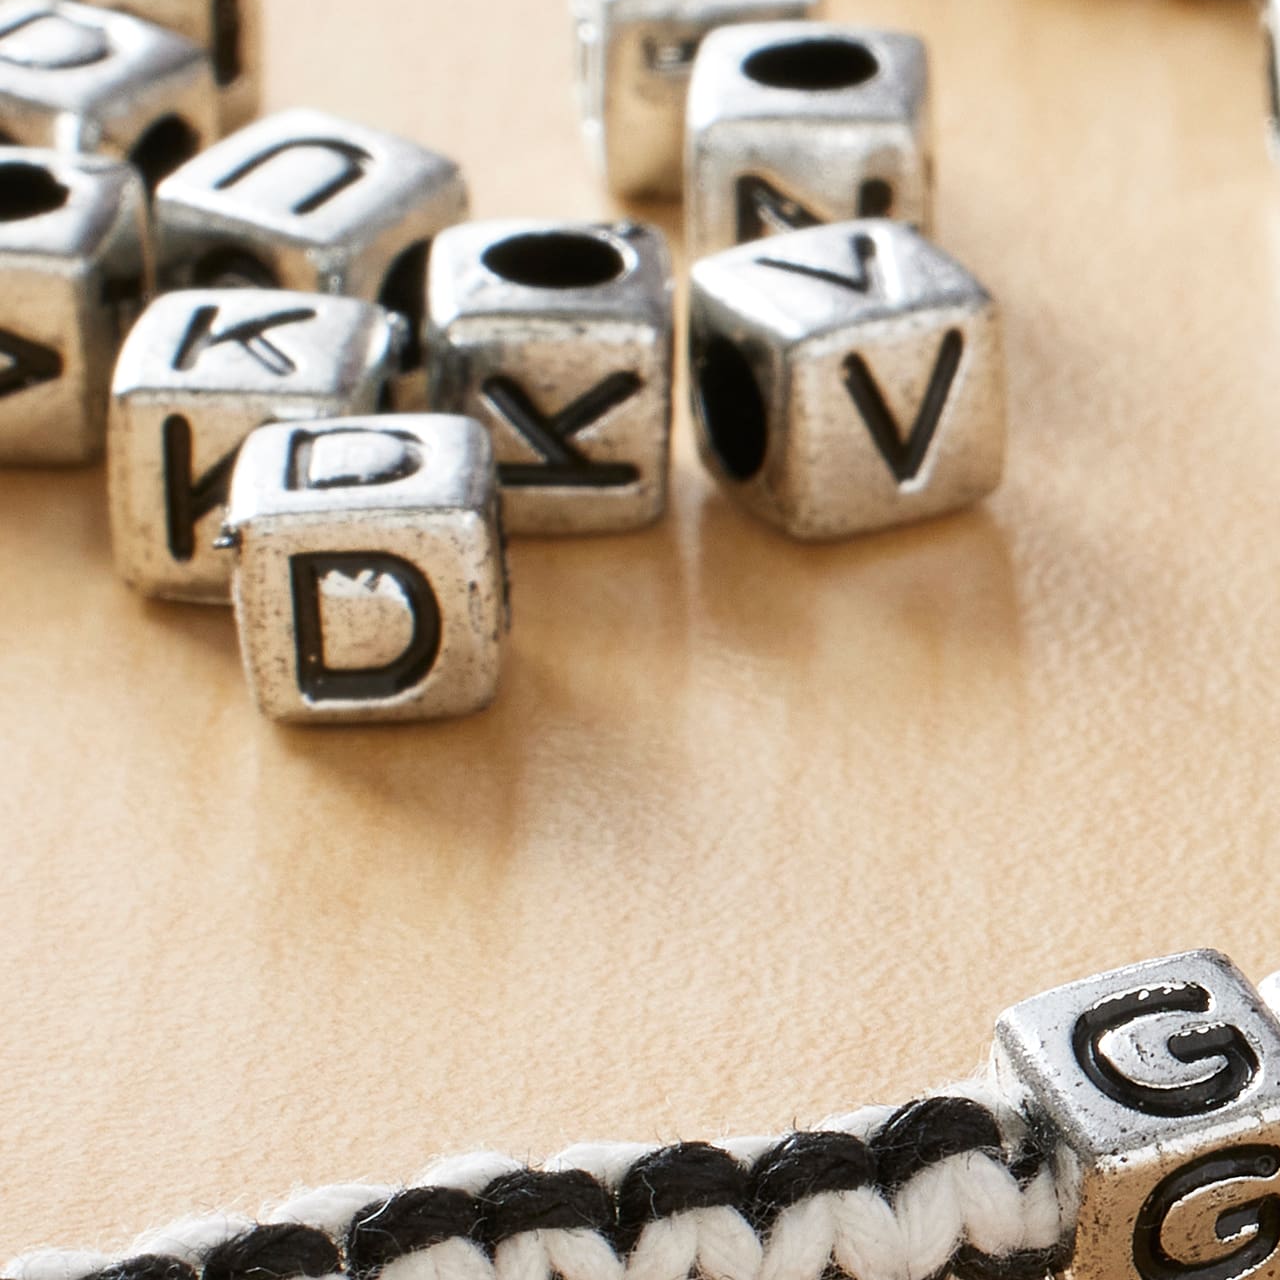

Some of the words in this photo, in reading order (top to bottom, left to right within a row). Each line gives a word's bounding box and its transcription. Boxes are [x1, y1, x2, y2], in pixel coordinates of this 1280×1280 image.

[753, 228, 896, 296] V
[172, 304, 319, 377] K
[481, 370, 645, 488] K
[841, 326, 964, 494] V
[284, 426, 430, 492] D
[290, 549, 443, 706] D
